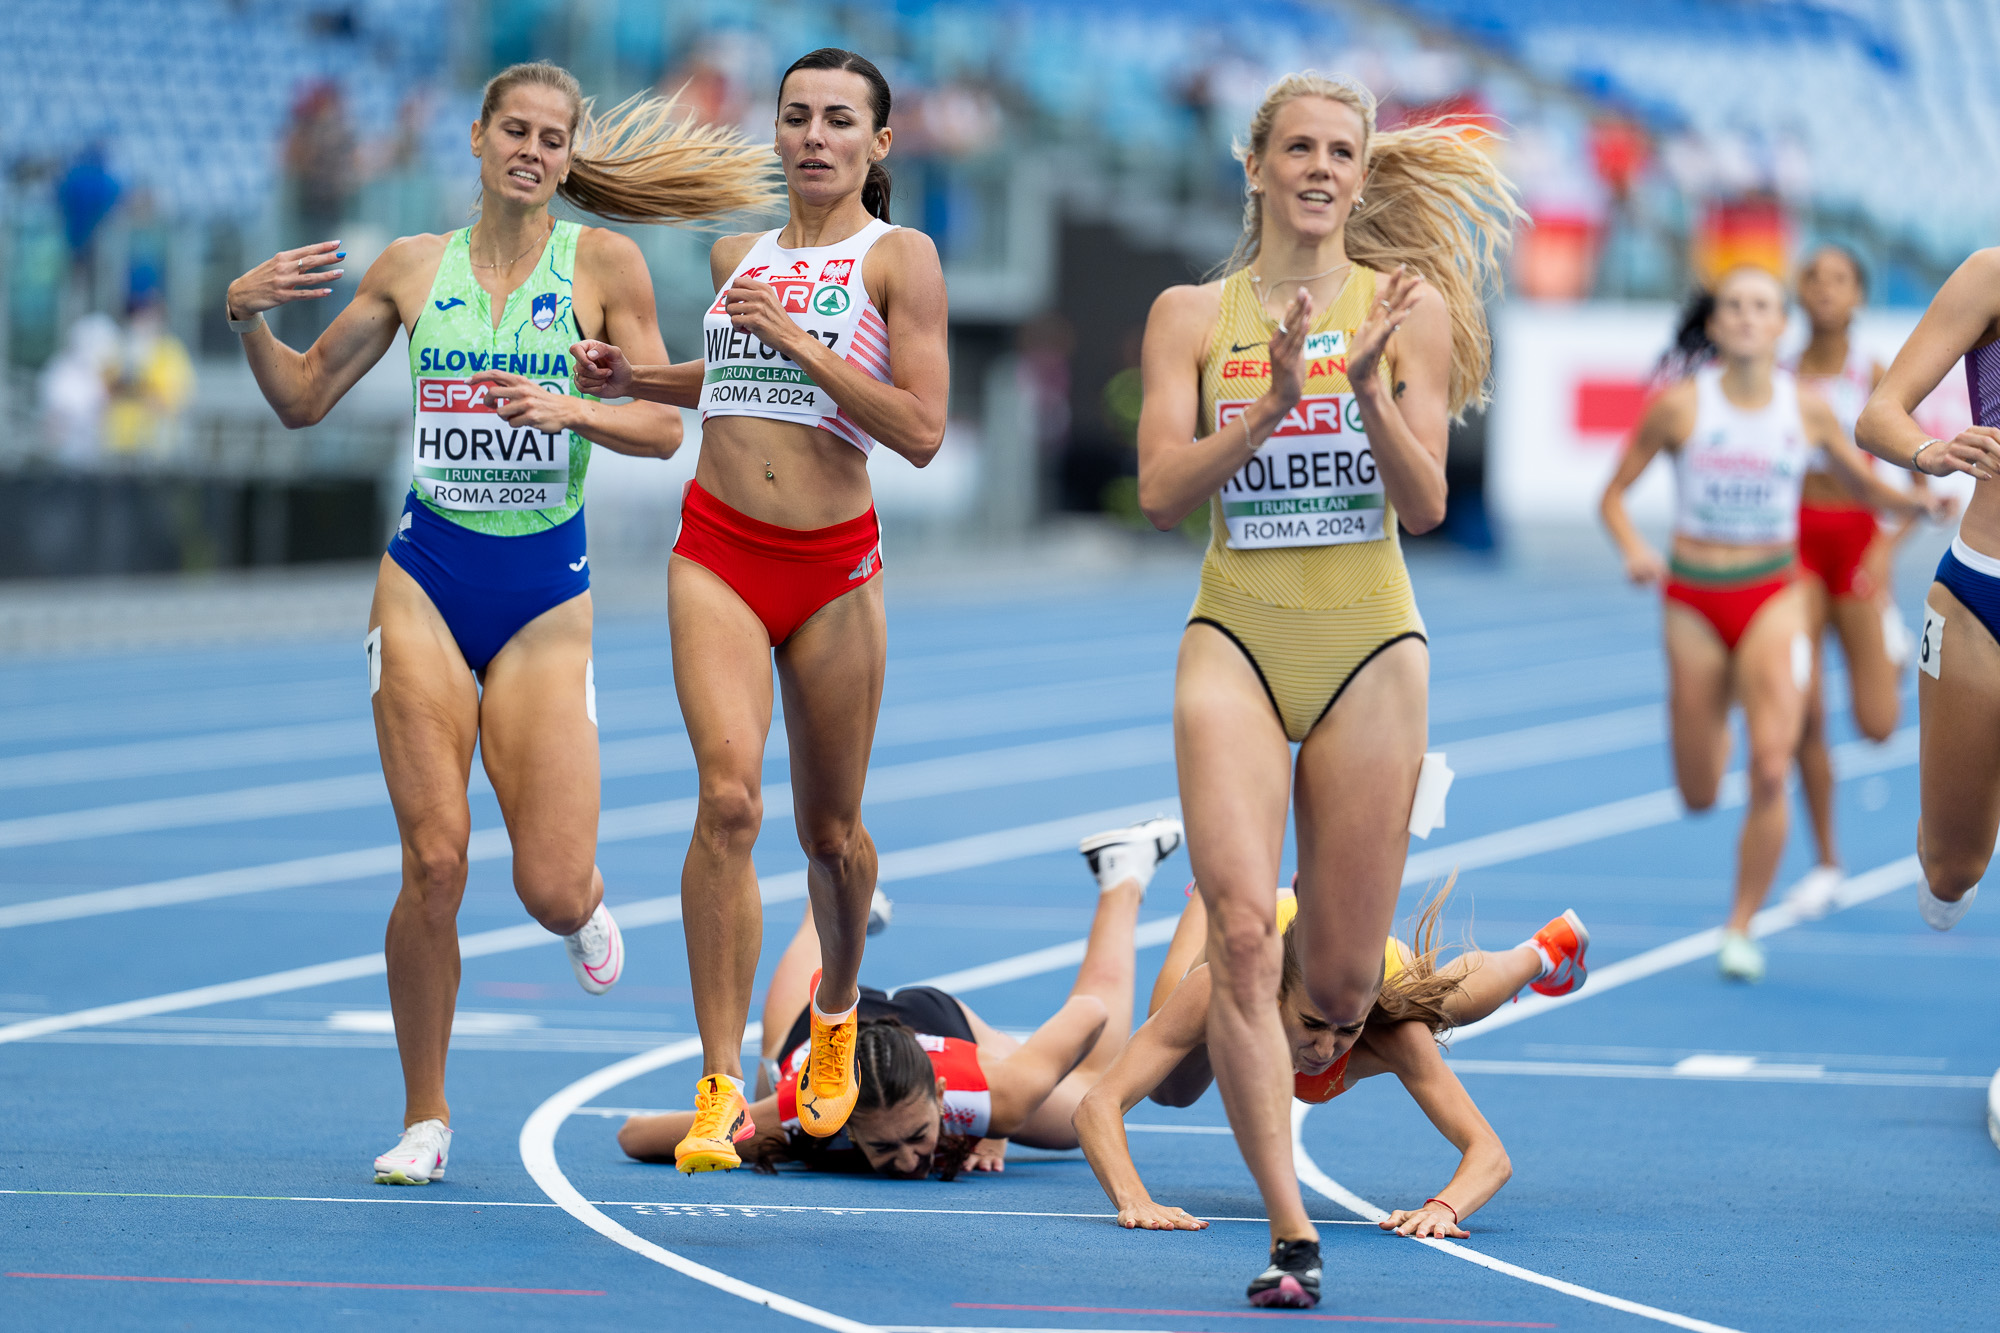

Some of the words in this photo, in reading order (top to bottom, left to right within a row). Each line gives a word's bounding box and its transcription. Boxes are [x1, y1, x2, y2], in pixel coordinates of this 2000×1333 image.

[420, 347, 569, 377] SLOVENIJA
[1222, 357, 1347, 379] GERAN
[727, 367, 753, 379] RUN
[710, 386, 762, 403] ROMA
[766, 388, 816, 407] 2024
[419, 427, 562, 462] HORVAT
[452, 469, 481, 481] RUN
[434, 485, 494, 504] ROMA
[499, 488, 546, 504] 2024
[1262, 500, 1296, 515] RUN
[1244, 520, 1311, 540] ROMA
[1316, 516, 1366, 537] 2024
[1921, 618, 1933, 664] 6
